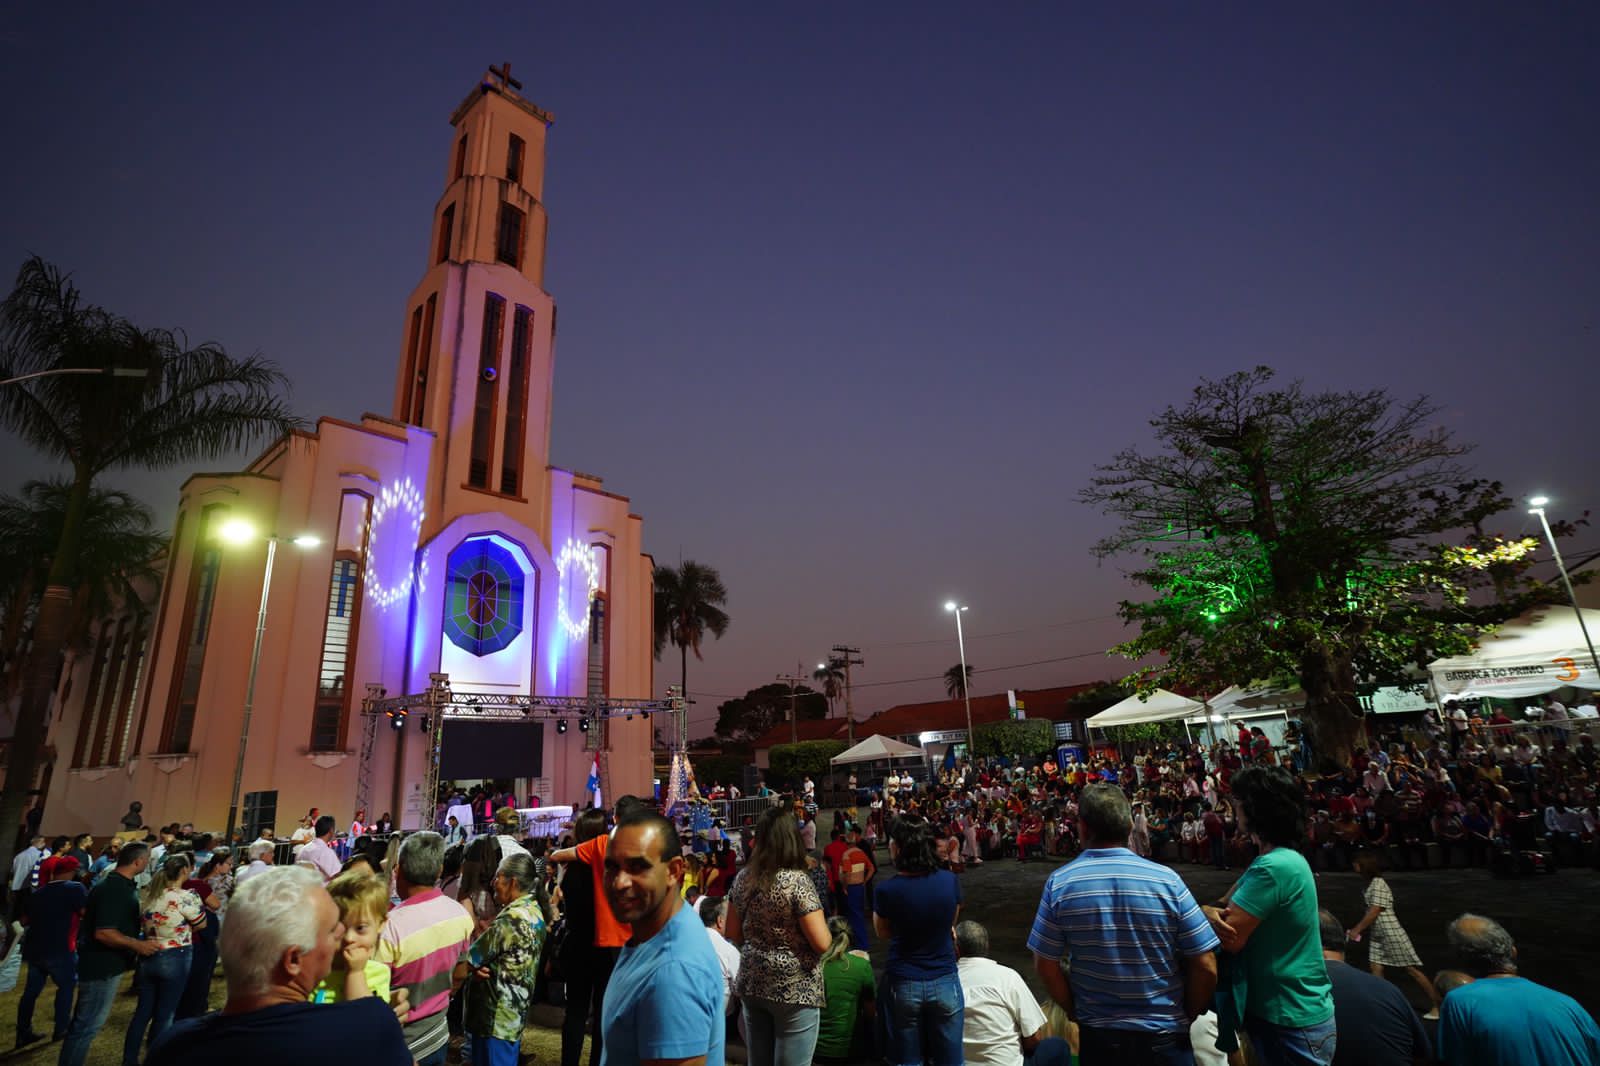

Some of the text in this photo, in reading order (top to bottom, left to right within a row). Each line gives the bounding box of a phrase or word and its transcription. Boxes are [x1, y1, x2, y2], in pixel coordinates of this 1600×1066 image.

[1445, 669, 1490, 682] BARRACA
[1493, 667, 1506, 678] DO
[1509, 664, 1545, 676] PRIMO
[1552, 657, 1581, 682] 3
